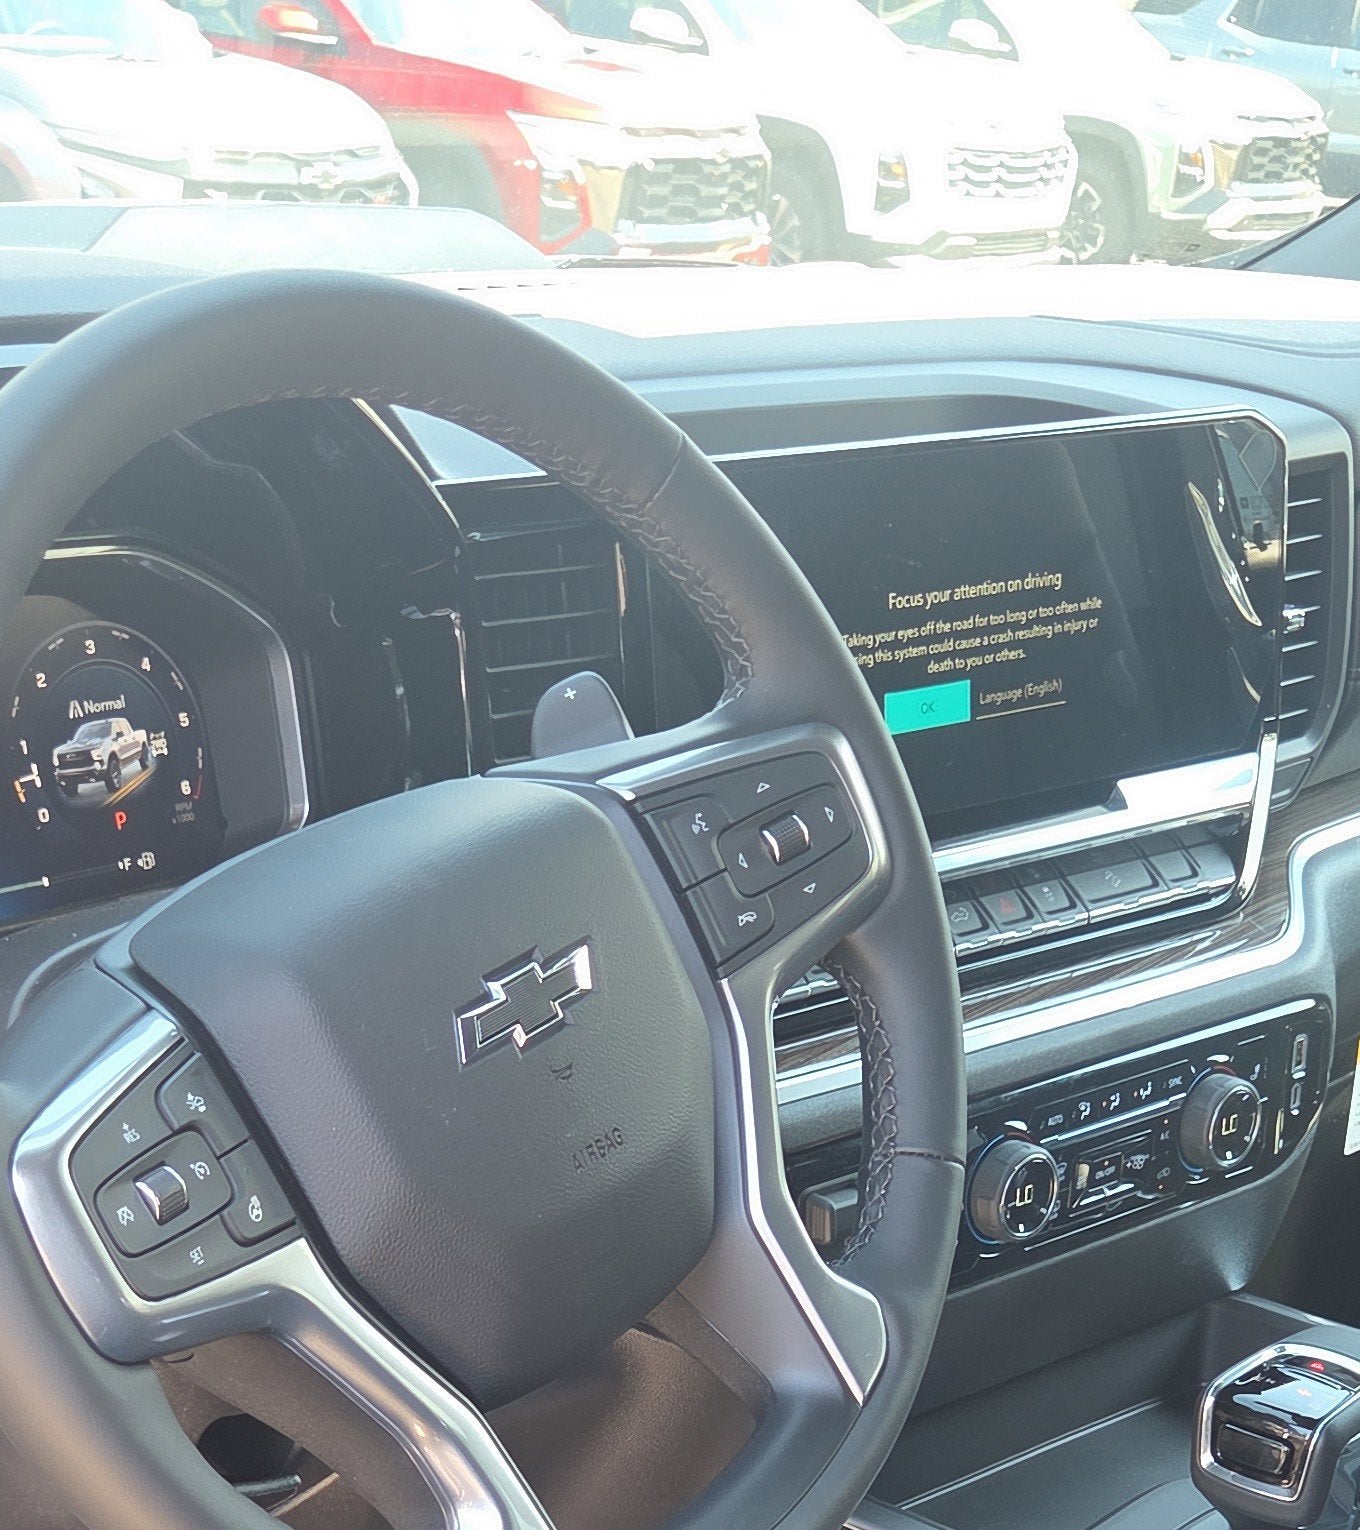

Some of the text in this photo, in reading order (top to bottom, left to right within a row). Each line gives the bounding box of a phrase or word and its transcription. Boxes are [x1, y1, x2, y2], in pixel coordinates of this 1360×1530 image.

[889, 572, 1062, 609] Focus your attention on driving
[875, 631, 896, 646] your
[898, 627, 919, 642] eyes
[920, 621, 935, 636] off
[936, 620, 951, 633] the
[953, 616, 974, 631] road
[975, 613, 988, 627] for
[990, 613, 1005, 625] too
[1006, 610, 1027, 625] long
[1028, 608, 1037, 619] or
[1039, 606, 1054, 618] too
[1055, 601, 1079, 615] often
[84, 639, 95, 655] 3
[875, 649, 893, 662] this
[895, 645, 927, 662] system
[929, 638, 953, 654] could
[955, 637, 981, 650] cause
[983, 636, 989, 645] a
[990, 629, 1013, 644] crash
[1015, 624, 1053, 639] resulting
[1054, 622, 1062, 633] in
[1063, 619, 1087, 635] injury
[1089, 618, 1099, 629] or
[141, 657, 151, 671] 4
[927, 658, 954, 674] death
[955, 658, 965, 669] to
[966, 656, 983, 671] you
[984, 653, 994, 664] or
[36, 673, 47, 688] 2
[979, 678, 1062, 705] Language (English)
[83, 695, 126, 714] Normal
[921, 701, 935, 714] OK
[178, 712, 189, 727] 5
[20, 739, 28, 755] 1
[38, 808, 50, 823] 0
[115, 811, 127, 830] P
[123, 858, 131, 870] F
[573, 1126, 624, 1176] AIRBAG
